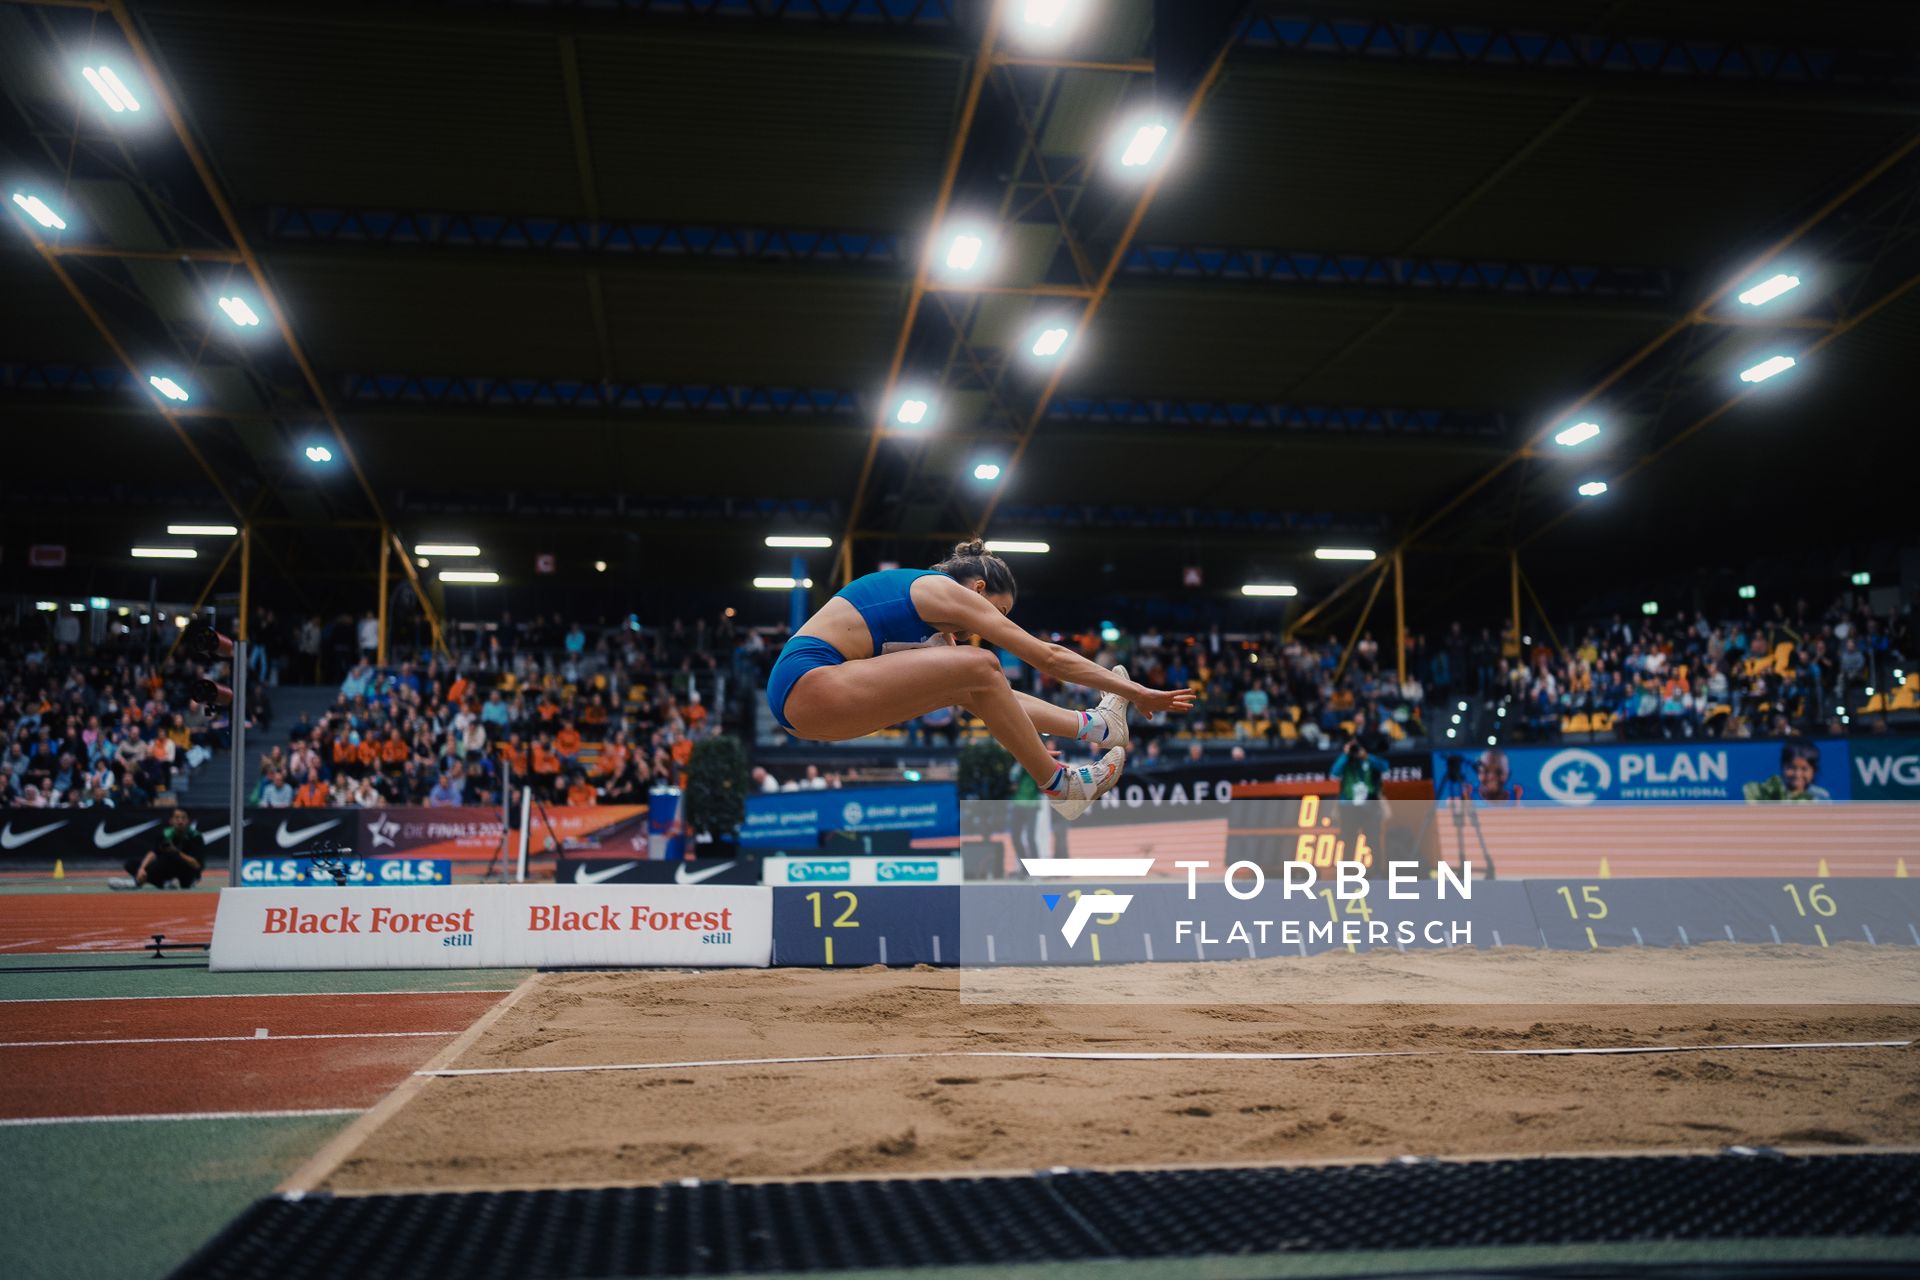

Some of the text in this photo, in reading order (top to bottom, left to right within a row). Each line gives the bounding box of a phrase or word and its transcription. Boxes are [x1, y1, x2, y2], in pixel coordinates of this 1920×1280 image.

[1619, 752, 1728, 783] PLAN
[1101, 779, 1257, 809] NOVAFO
[1620, 786, 1728, 798] INTERNATIONAL
[427, 822, 477, 839] FINALS
[479, 822, 504, 837] 202
[242, 859, 304, 881] GLS.
[380, 859, 442, 881] GLS.
[806, 891, 860, 928] 12
[1319, 887, 1373, 923] 14
[1557, 885, 1609, 920] 15
[1784, 883, 1838, 917] 16
[262, 907, 475, 934] Black Forest
[528, 905, 732, 932] Black Forest
[443, 933, 473, 947] still
[702, 932, 732, 945] still
